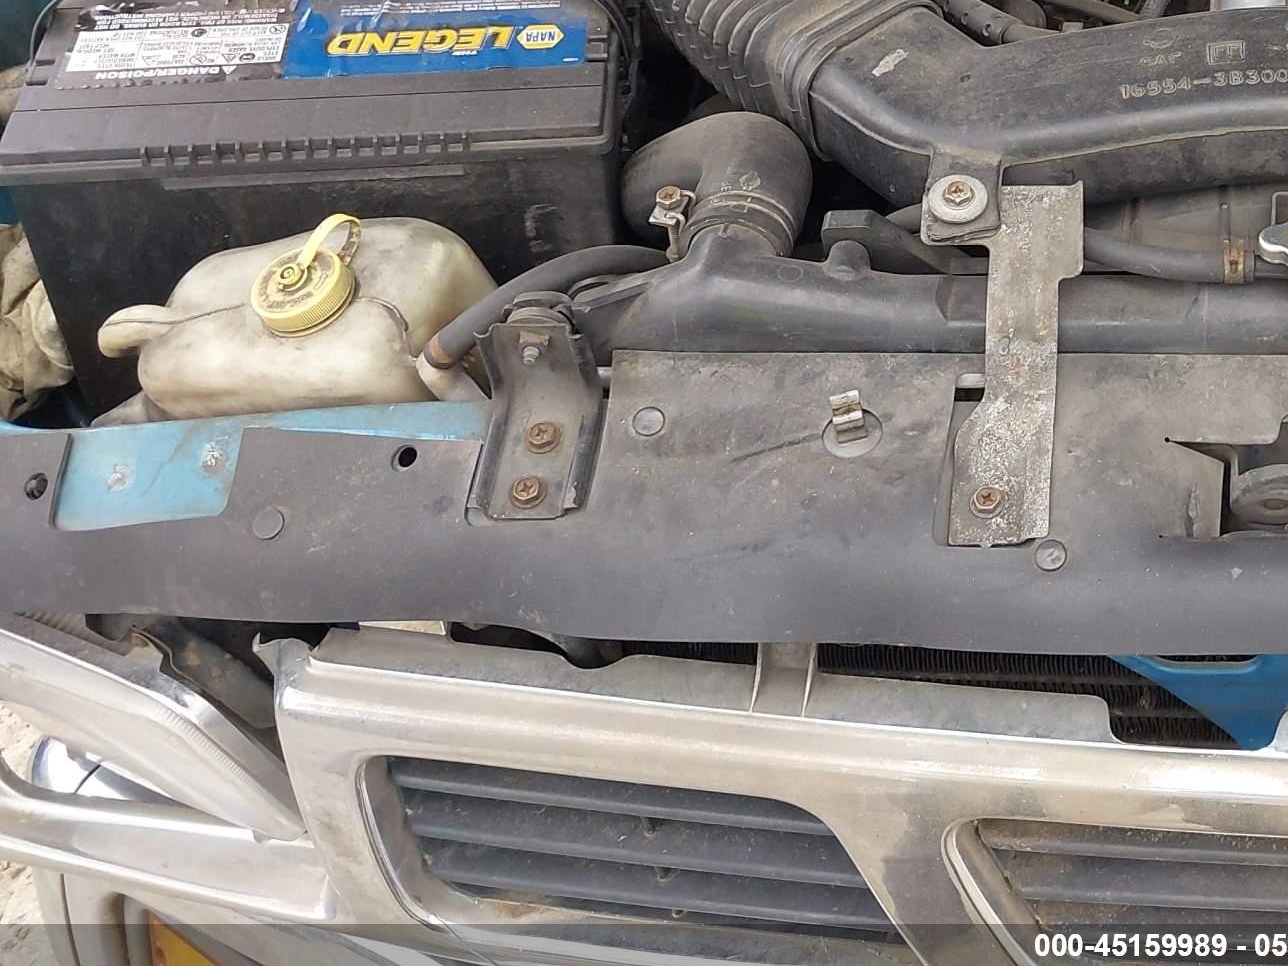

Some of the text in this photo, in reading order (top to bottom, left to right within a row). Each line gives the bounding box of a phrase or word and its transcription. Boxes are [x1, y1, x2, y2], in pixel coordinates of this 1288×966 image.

[325, 24, 515, 57] LEGEND
[525, 30, 556, 43] NAPA
[95, 66, 220, 80] DANGER/POISON
